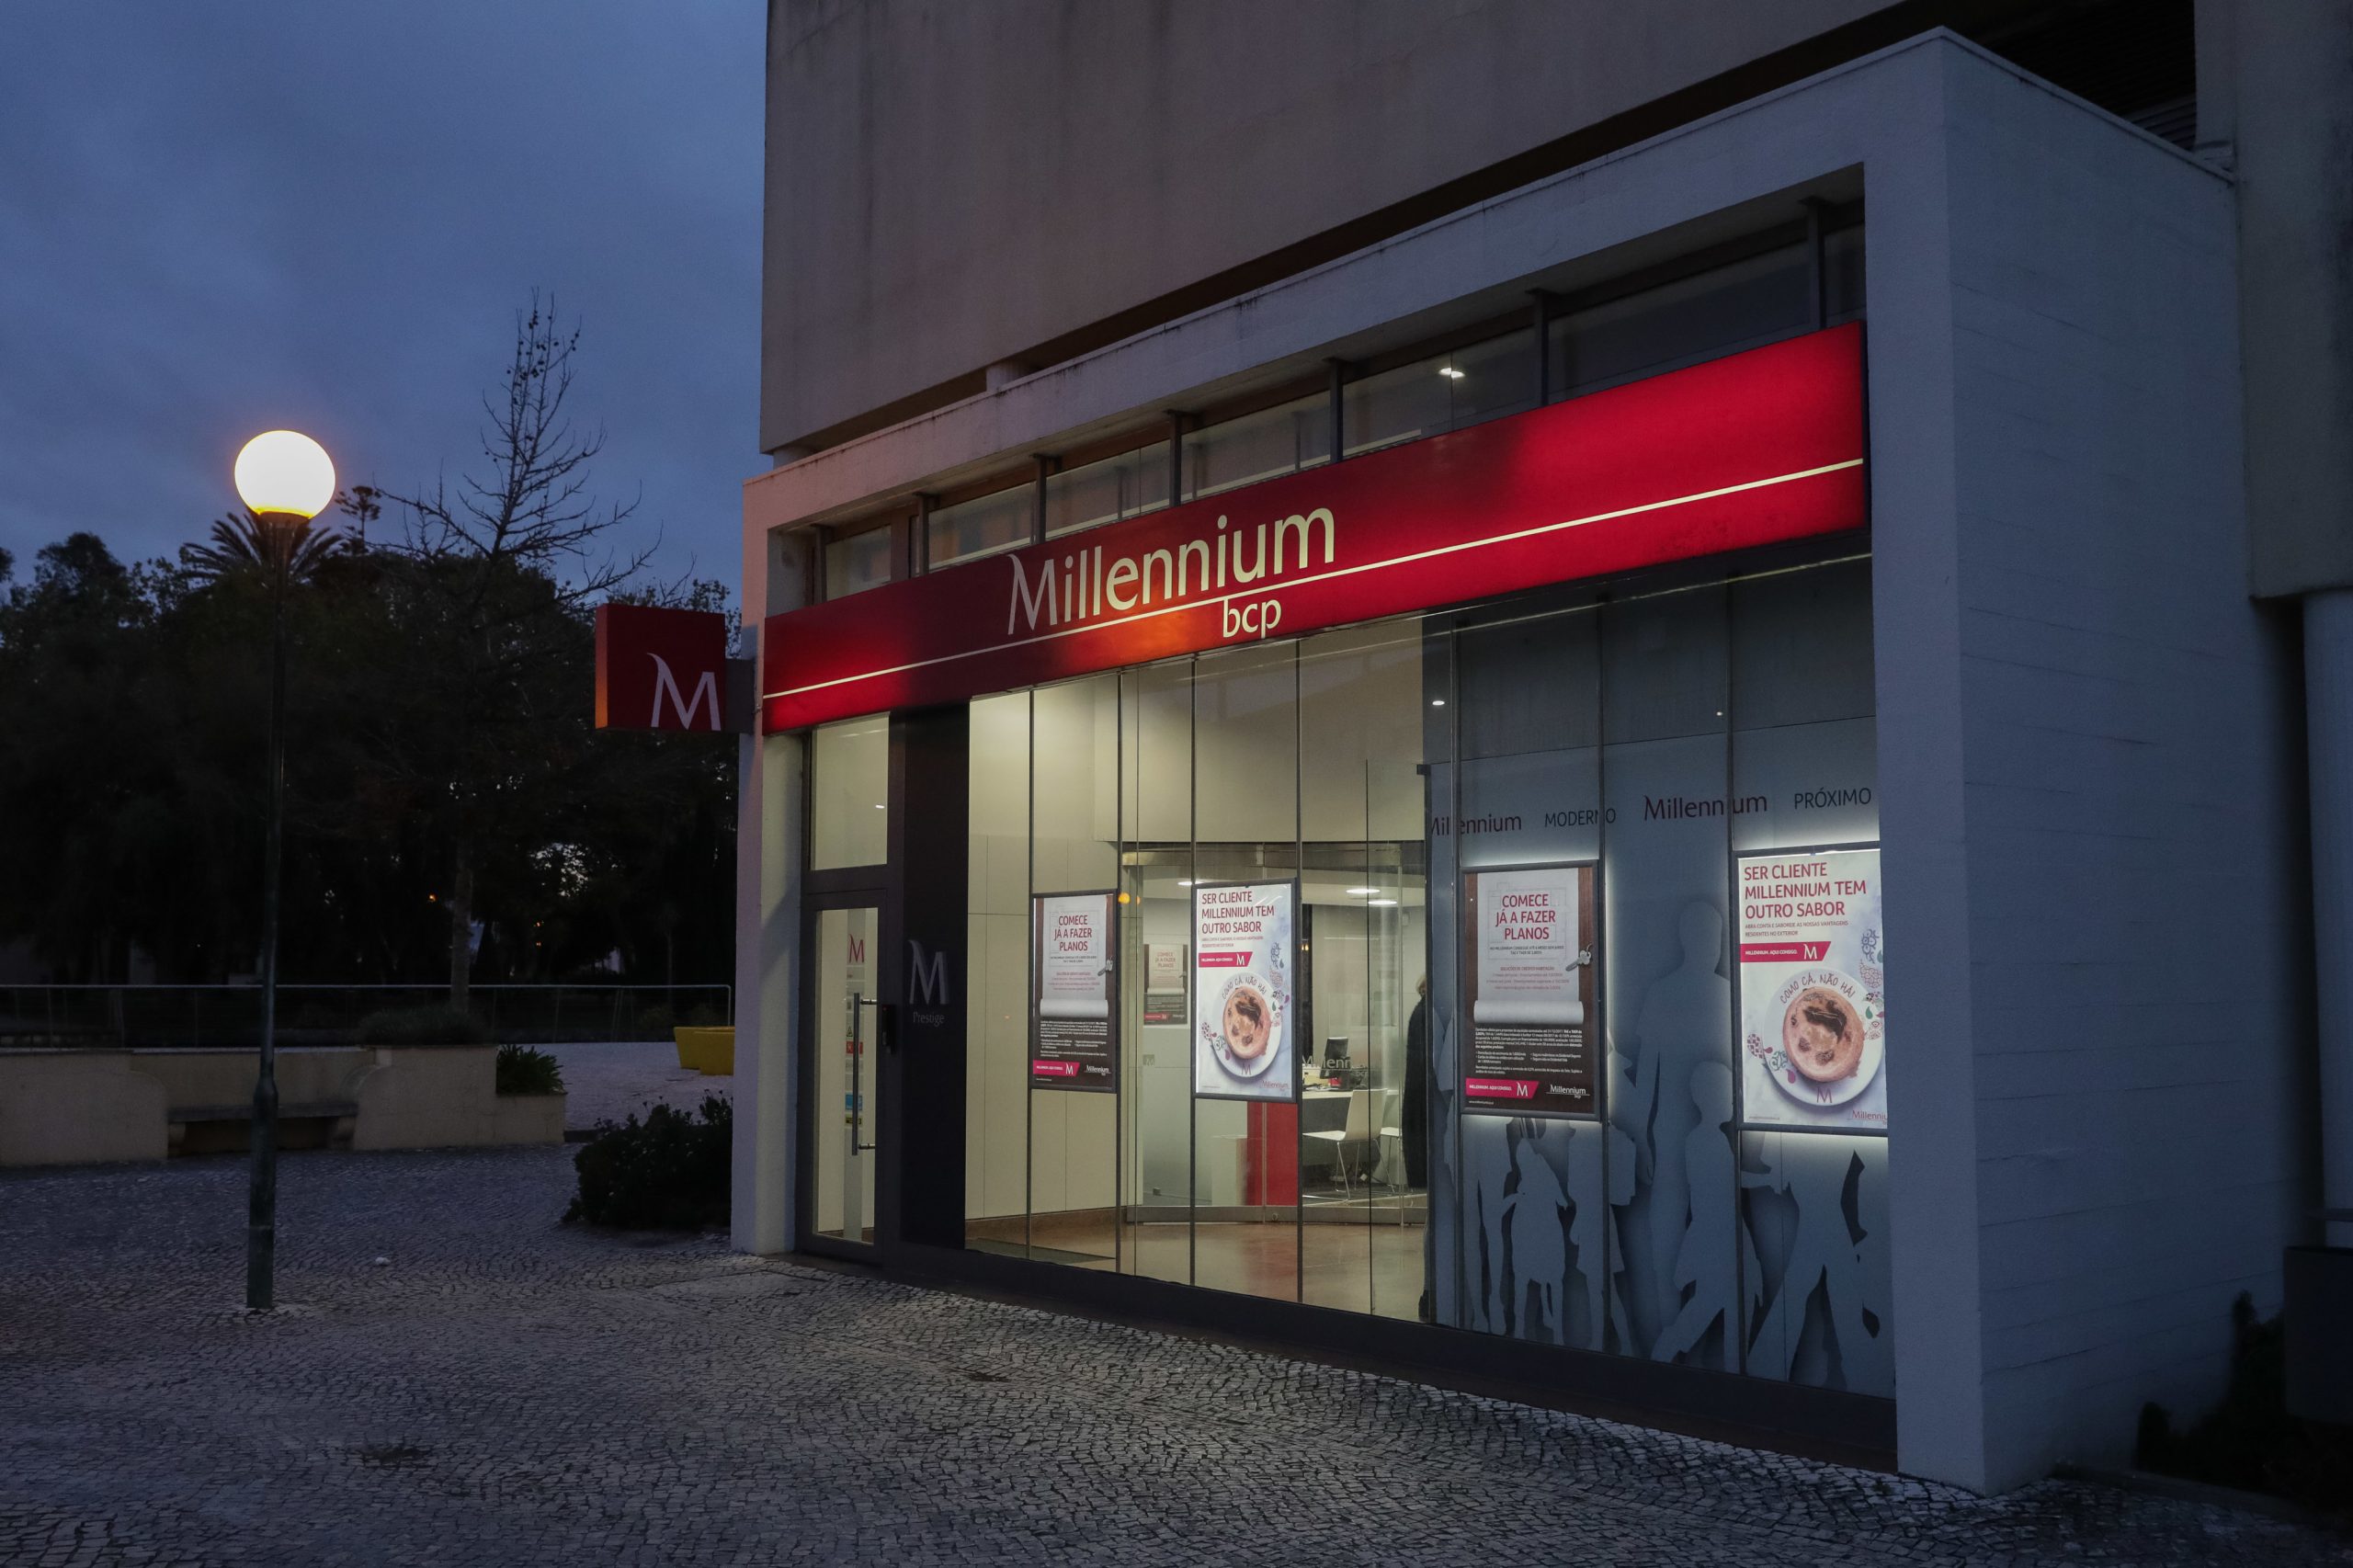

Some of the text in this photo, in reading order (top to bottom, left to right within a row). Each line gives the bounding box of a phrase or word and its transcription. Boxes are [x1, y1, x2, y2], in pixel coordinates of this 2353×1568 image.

[1006, 507, 1335, 635] Millennium
[1223, 598, 1281, 639] bcp
[646, 652, 722, 732] M
[1643, 787, 1872, 821] Millennum PRÓXIMO
[1431, 813, 1522, 836] Milennium
[1744, 862, 1827, 881] SER CLIENTE
[1201, 891, 1253, 904] SER CLIENTE
[1745, 880, 1867, 900] MILLENNIUM TEM
[1502, 893, 1549, 908] COMECE
[1201, 905, 1275, 919] MILLENNIUM TEM
[1495, 908, 1556, 927] JÁ A FAZER
[1745, 901, 1846, 919] OUTRO SABOR
[1058, 915, 1088, 926] COMECE
[1201, 921, 1262, 934] OUTRO SABOR
[1053, 926, 1093, 941] JÁ A FAZER
[1504, 926, 1550, 940] PLANOS
[848, 933, 865, 963] M
[1059, 940, 1088, 951] PLANOS
[1803, 943, 1818, 960] M
[1236, 952, 1245, 966] M
[907, 938, 949, 1005] M
[1820, 972, 1838, 986] NÃO
[1065, 1062, 1074, 1075] M
[1516, 1082, 1586, 1096] M Millennium
[1816, 1086, 1833, 1103] M
[1852, 1109, 1887, 1120] Millenni
